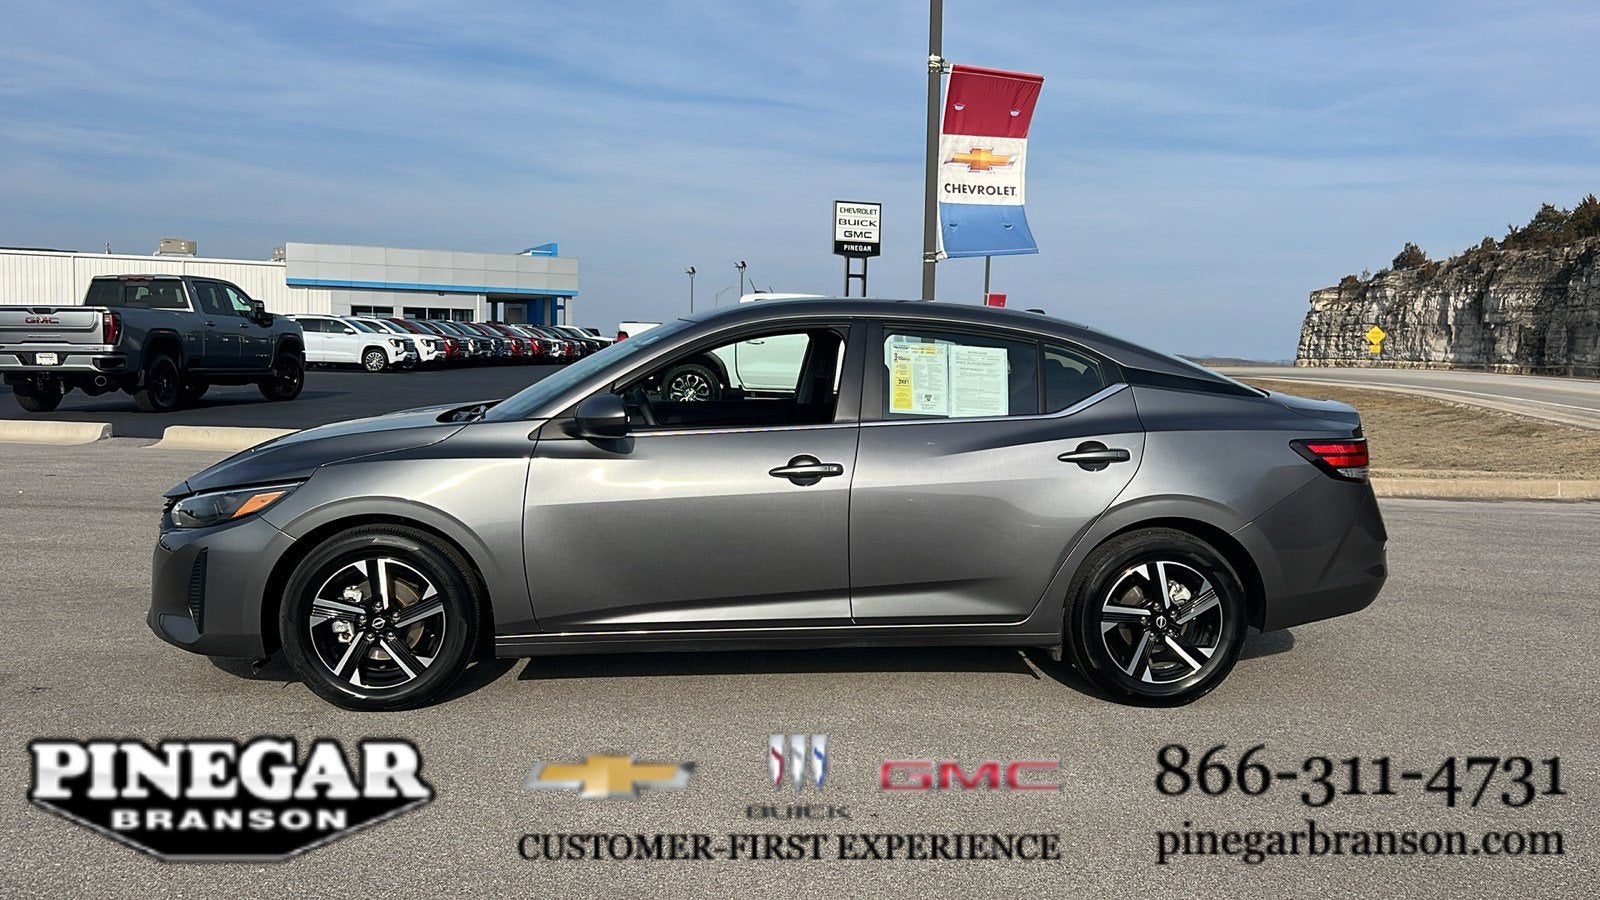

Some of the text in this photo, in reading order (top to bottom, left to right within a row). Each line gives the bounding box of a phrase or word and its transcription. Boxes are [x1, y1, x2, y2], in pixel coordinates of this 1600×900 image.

[944, 183, 1016, 196] CHEVROLET
[839, 206, 878, 215] CHEVROLET
[838, 218, 878, 227] BUICK
[843, 230, 873, 239] GMC
[843, 244, 872, 252] PINEGAR
[25, 316, 60, 324] GMC
